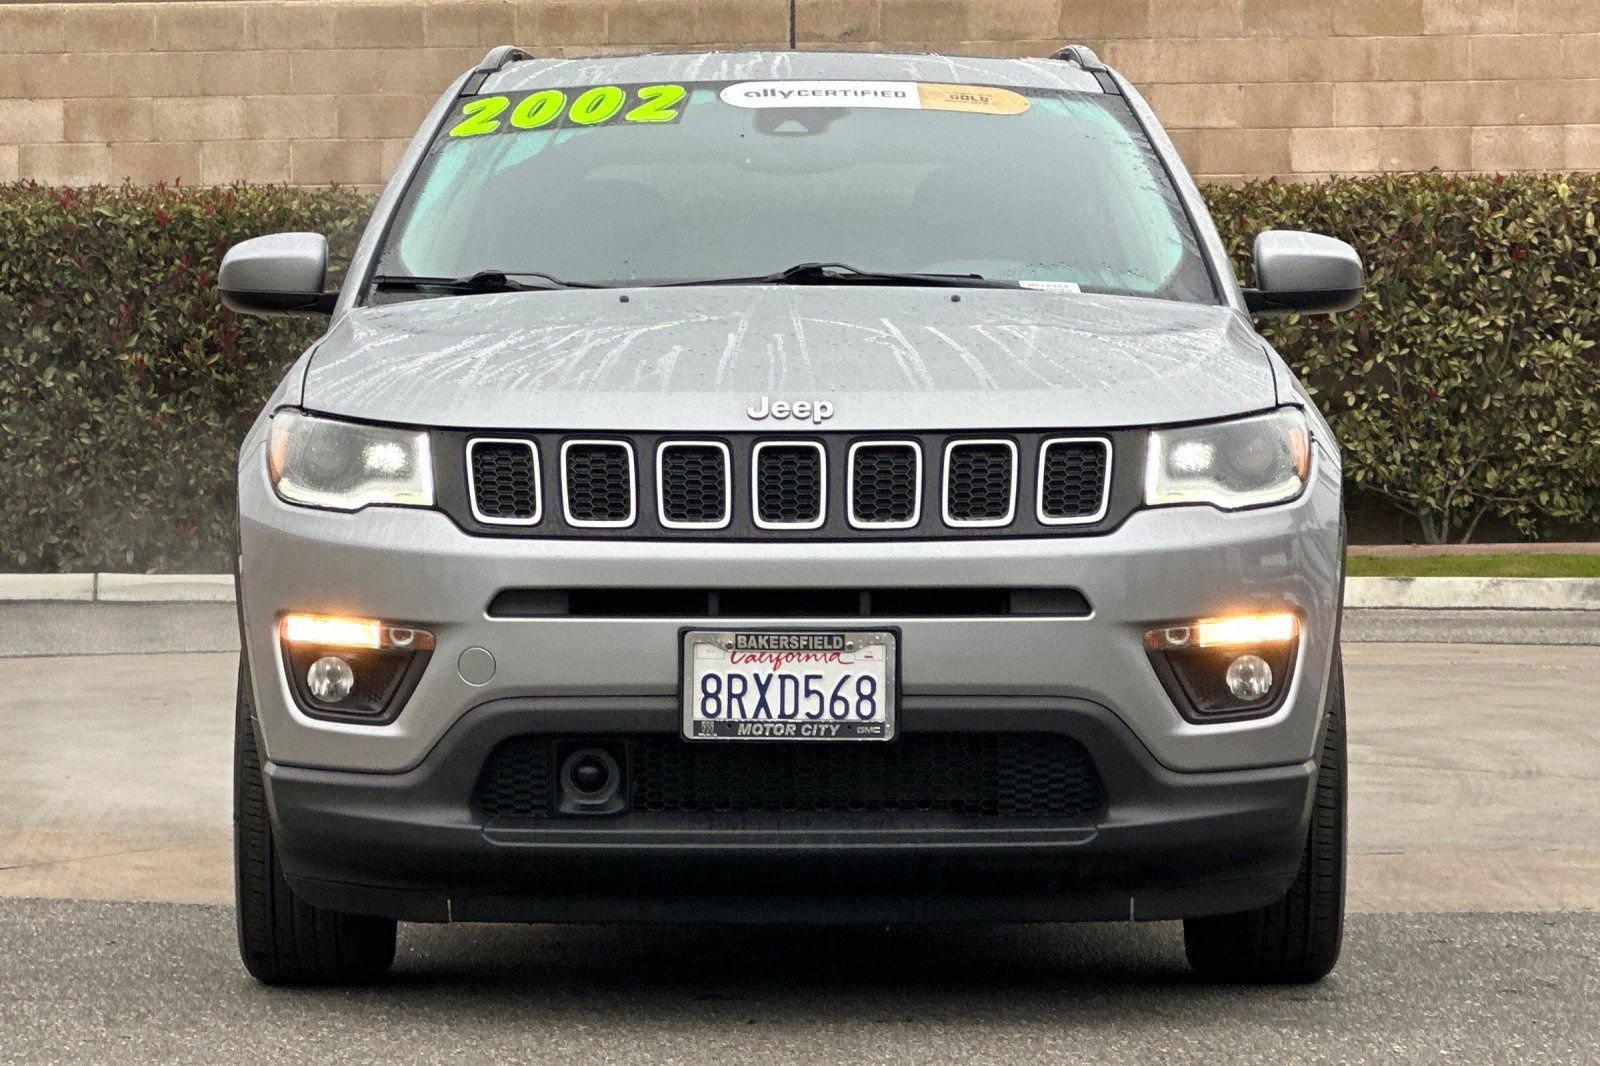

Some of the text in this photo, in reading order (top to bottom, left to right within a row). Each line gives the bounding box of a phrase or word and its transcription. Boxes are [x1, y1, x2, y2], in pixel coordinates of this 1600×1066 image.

[744, 88, 907, 99] ally CERTIFIED
[949, 94, 989, 103] GOLD
[449, 85, 687, 136] 2002
[747, 396, 834, 424] Jeep
[737, 635, 843, 650] BAKERSFIELD
[700, 673, 877, 720] 8RXD568
[737, 724, 841, 736] MOTOR CITY
